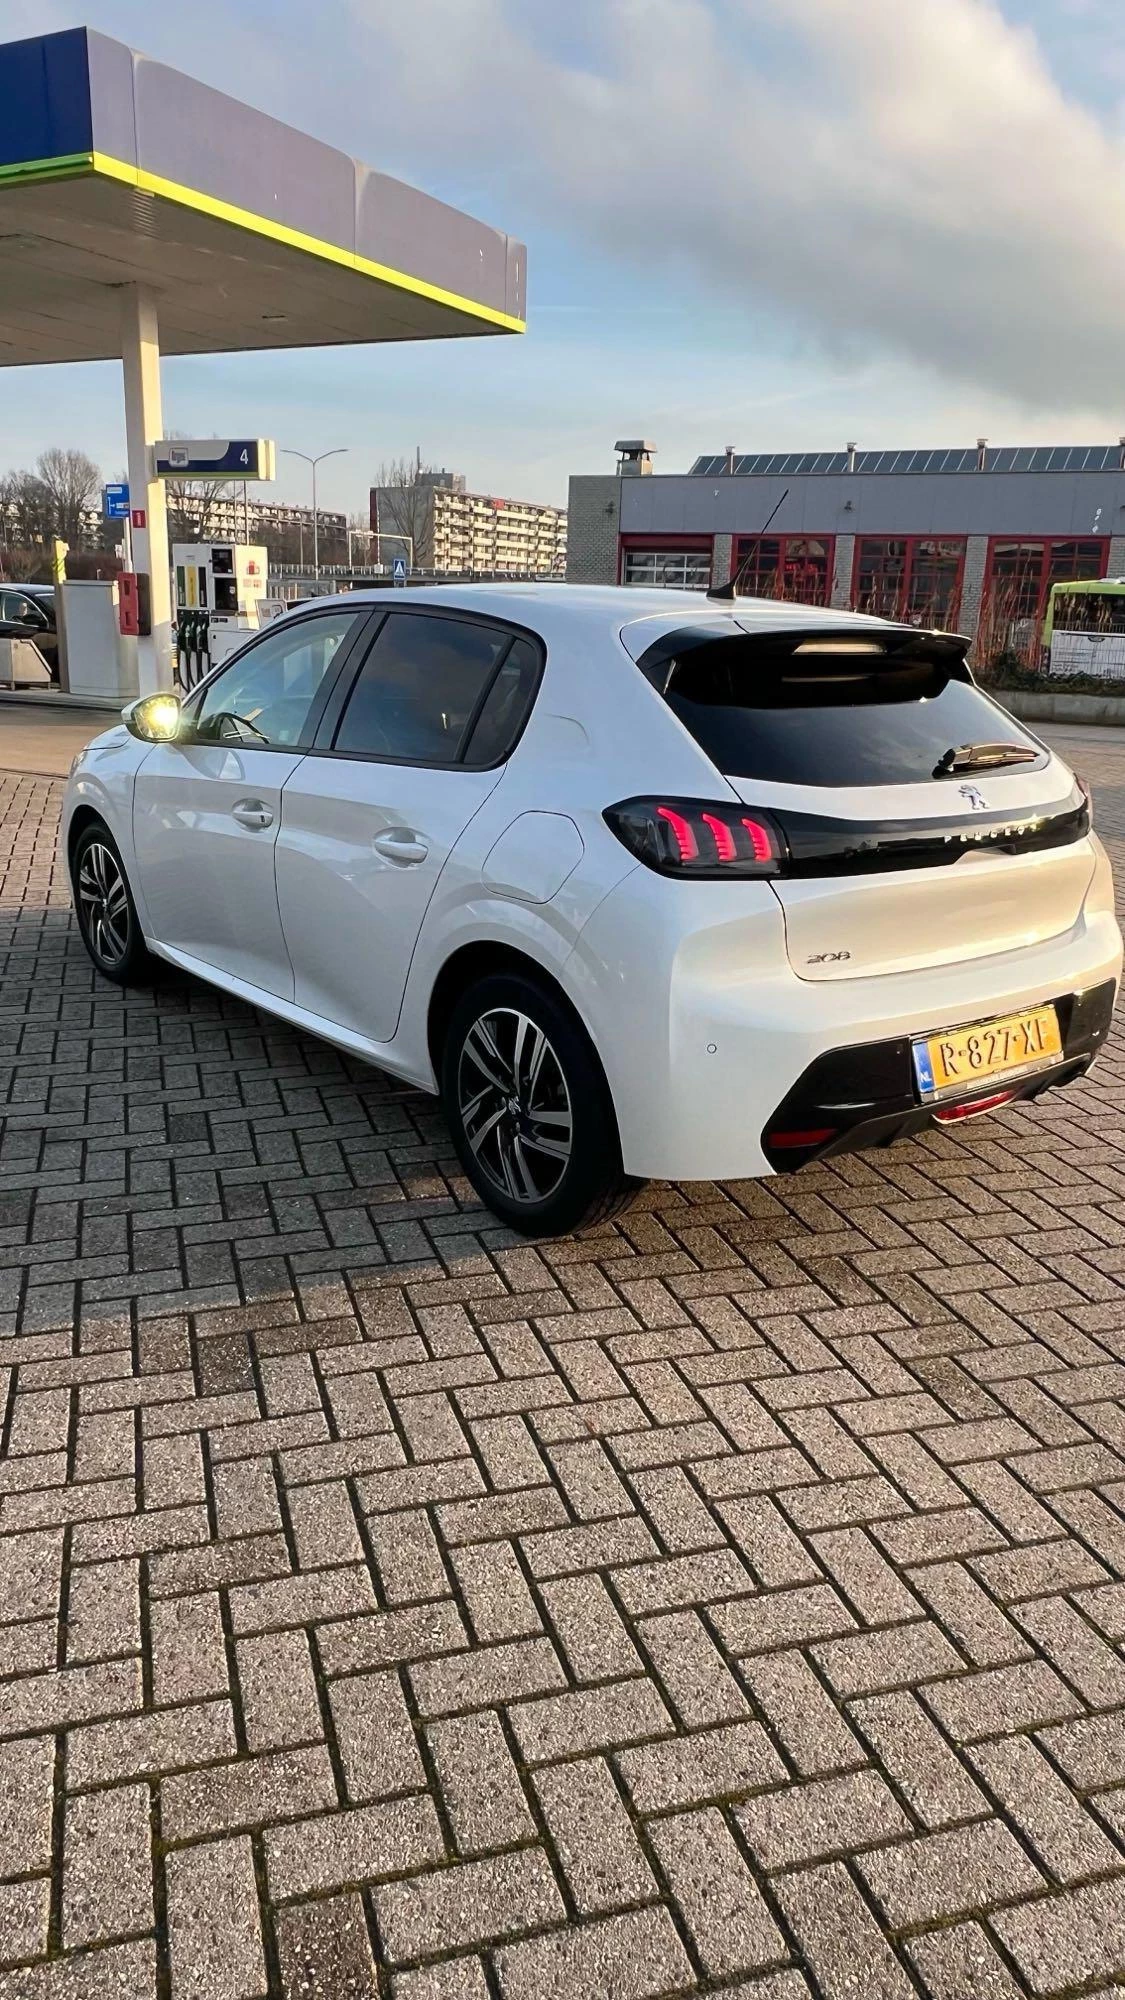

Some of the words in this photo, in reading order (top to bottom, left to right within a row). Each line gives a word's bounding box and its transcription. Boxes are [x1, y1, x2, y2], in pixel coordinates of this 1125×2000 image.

[239, 448, 249, 465] 4
[807, 951, 851, 964] 208
[920, 1071, 932, 1083] NL
